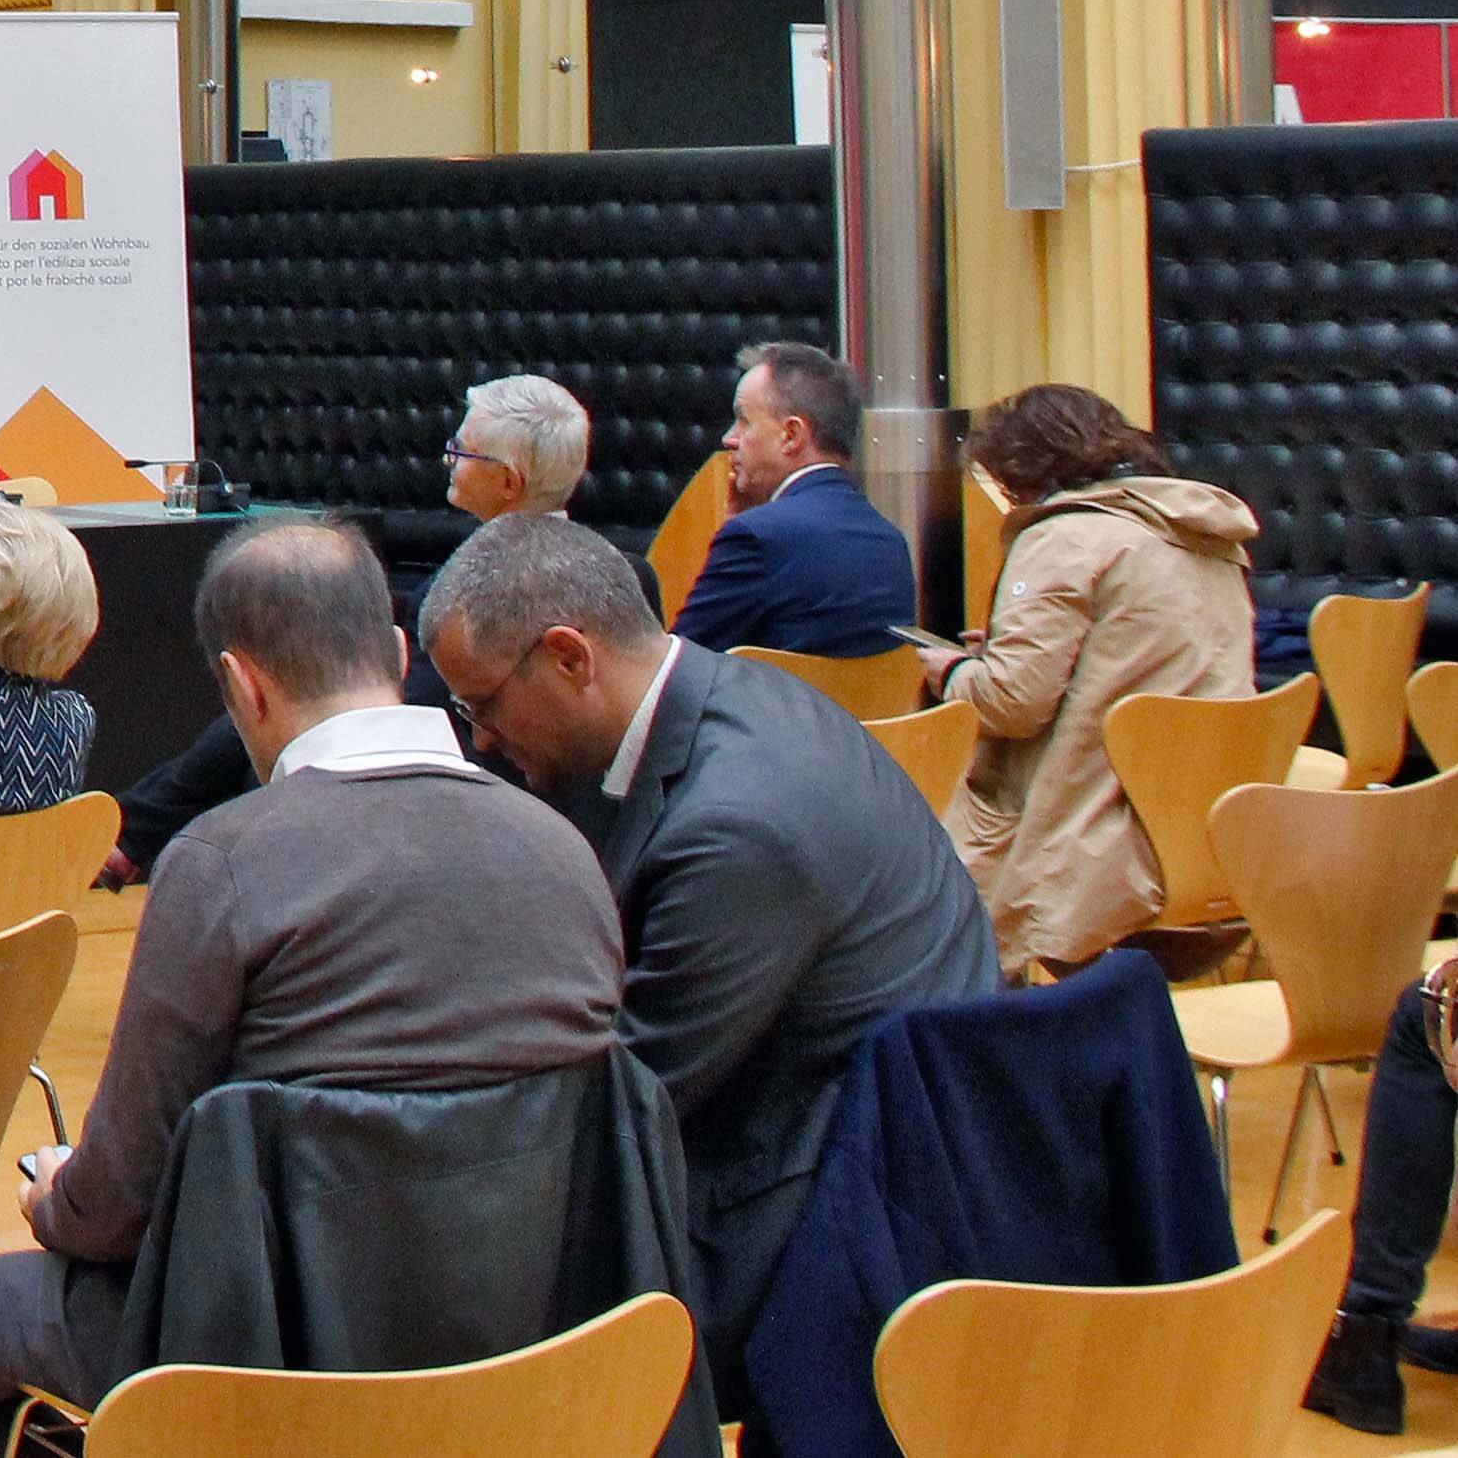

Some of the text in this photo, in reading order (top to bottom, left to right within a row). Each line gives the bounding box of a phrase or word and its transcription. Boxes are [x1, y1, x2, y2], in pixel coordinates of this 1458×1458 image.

[12, 239, 36, 251] den
[40, 238, 88, 250] sozialen
[91, 237, 150, 250] Wohnbau
[14, 259, 35, 274] per
[89, 254, 131, 268] sociale
[7, 277, 28, 290] por
[30, 273, 42, 286] le
[98, 272, 132, 285] sozial
